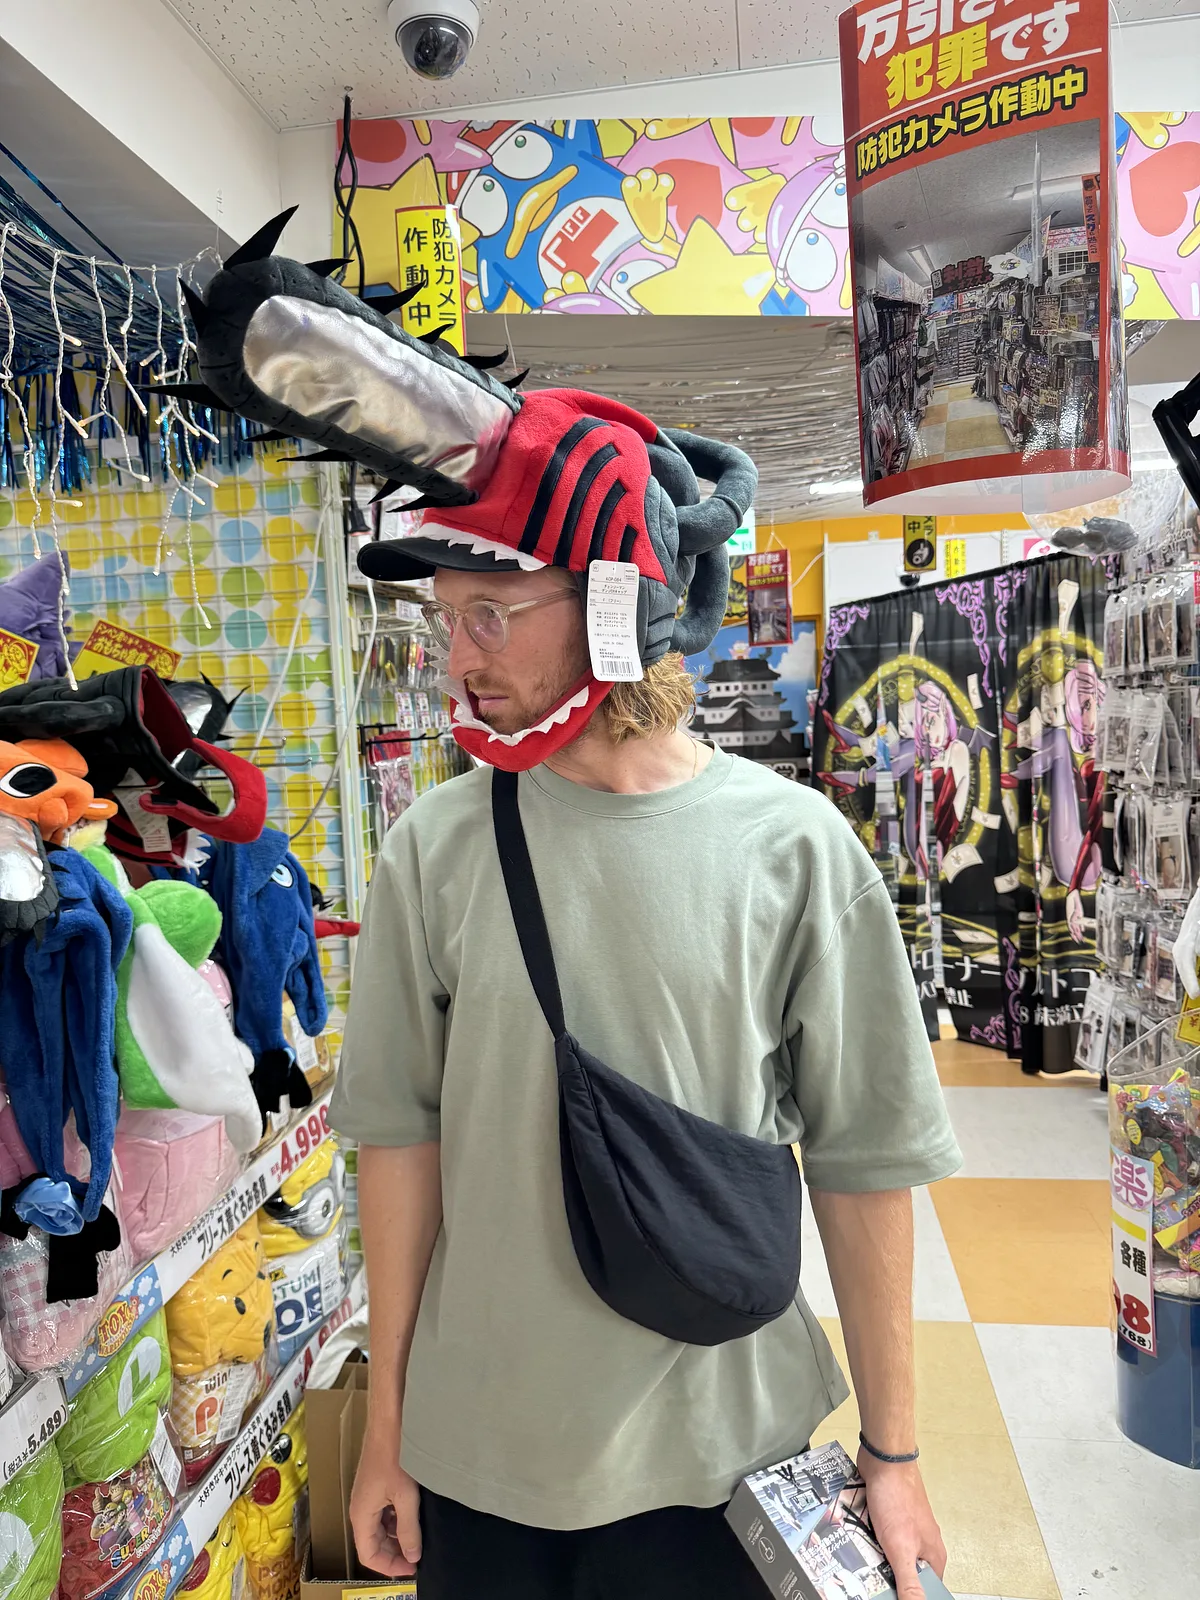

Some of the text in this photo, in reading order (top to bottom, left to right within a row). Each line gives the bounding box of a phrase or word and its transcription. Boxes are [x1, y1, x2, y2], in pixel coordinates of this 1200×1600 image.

[886, 1, 1080, 109] 犯罪です
[857, 69, 1084, 177] 防犯カメラ作動中
[403, 227, 432, 327] 作動中
[432, 218, 457, 331] 防犯カメラ
[1120, 1240, 1147, 1277] 各種
[98, 1302, 129, 1343] TOY
[111, 1527, 149, 1568] SUPER
